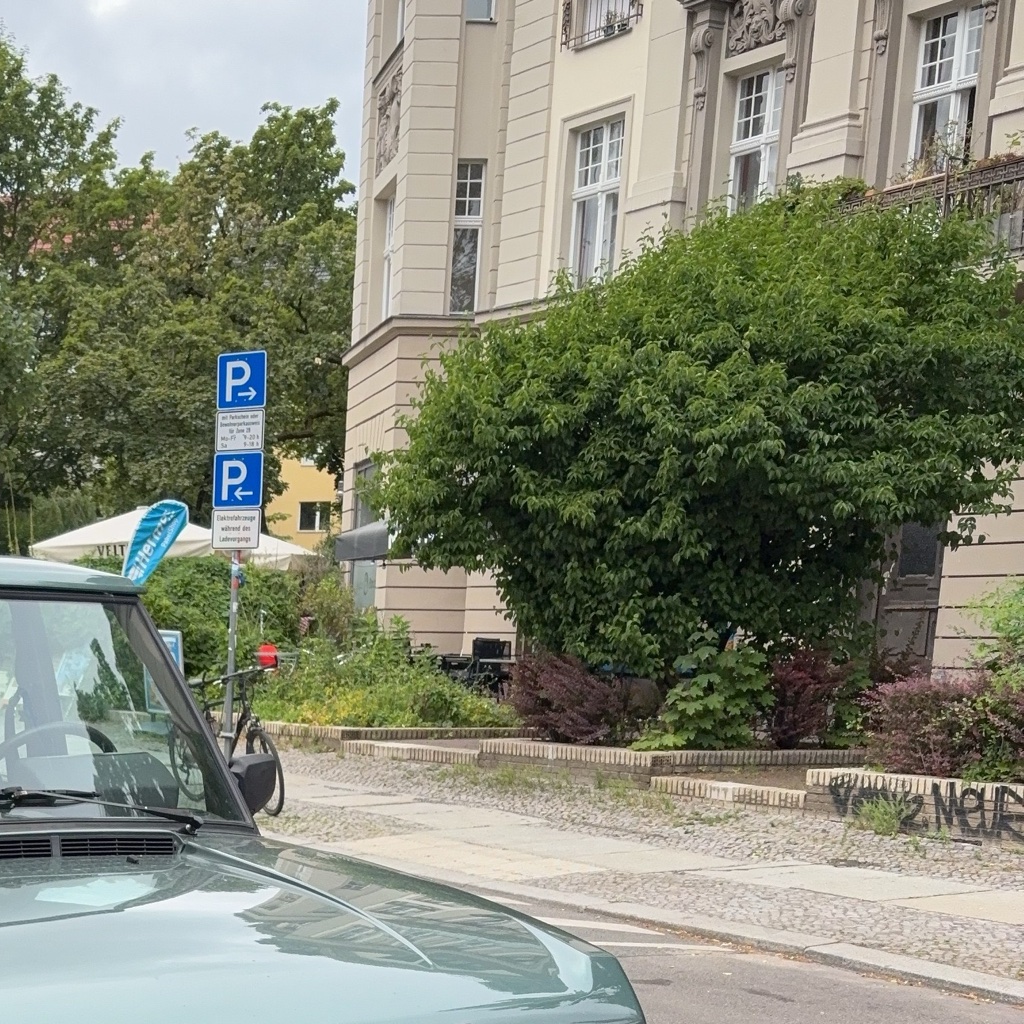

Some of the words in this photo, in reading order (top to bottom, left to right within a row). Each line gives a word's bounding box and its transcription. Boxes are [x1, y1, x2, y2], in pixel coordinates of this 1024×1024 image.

[226, 360, 251, 402] P
[221, 460, 247, 501] P
[216, 514, 256, 523] Elektrofahrzeuge
